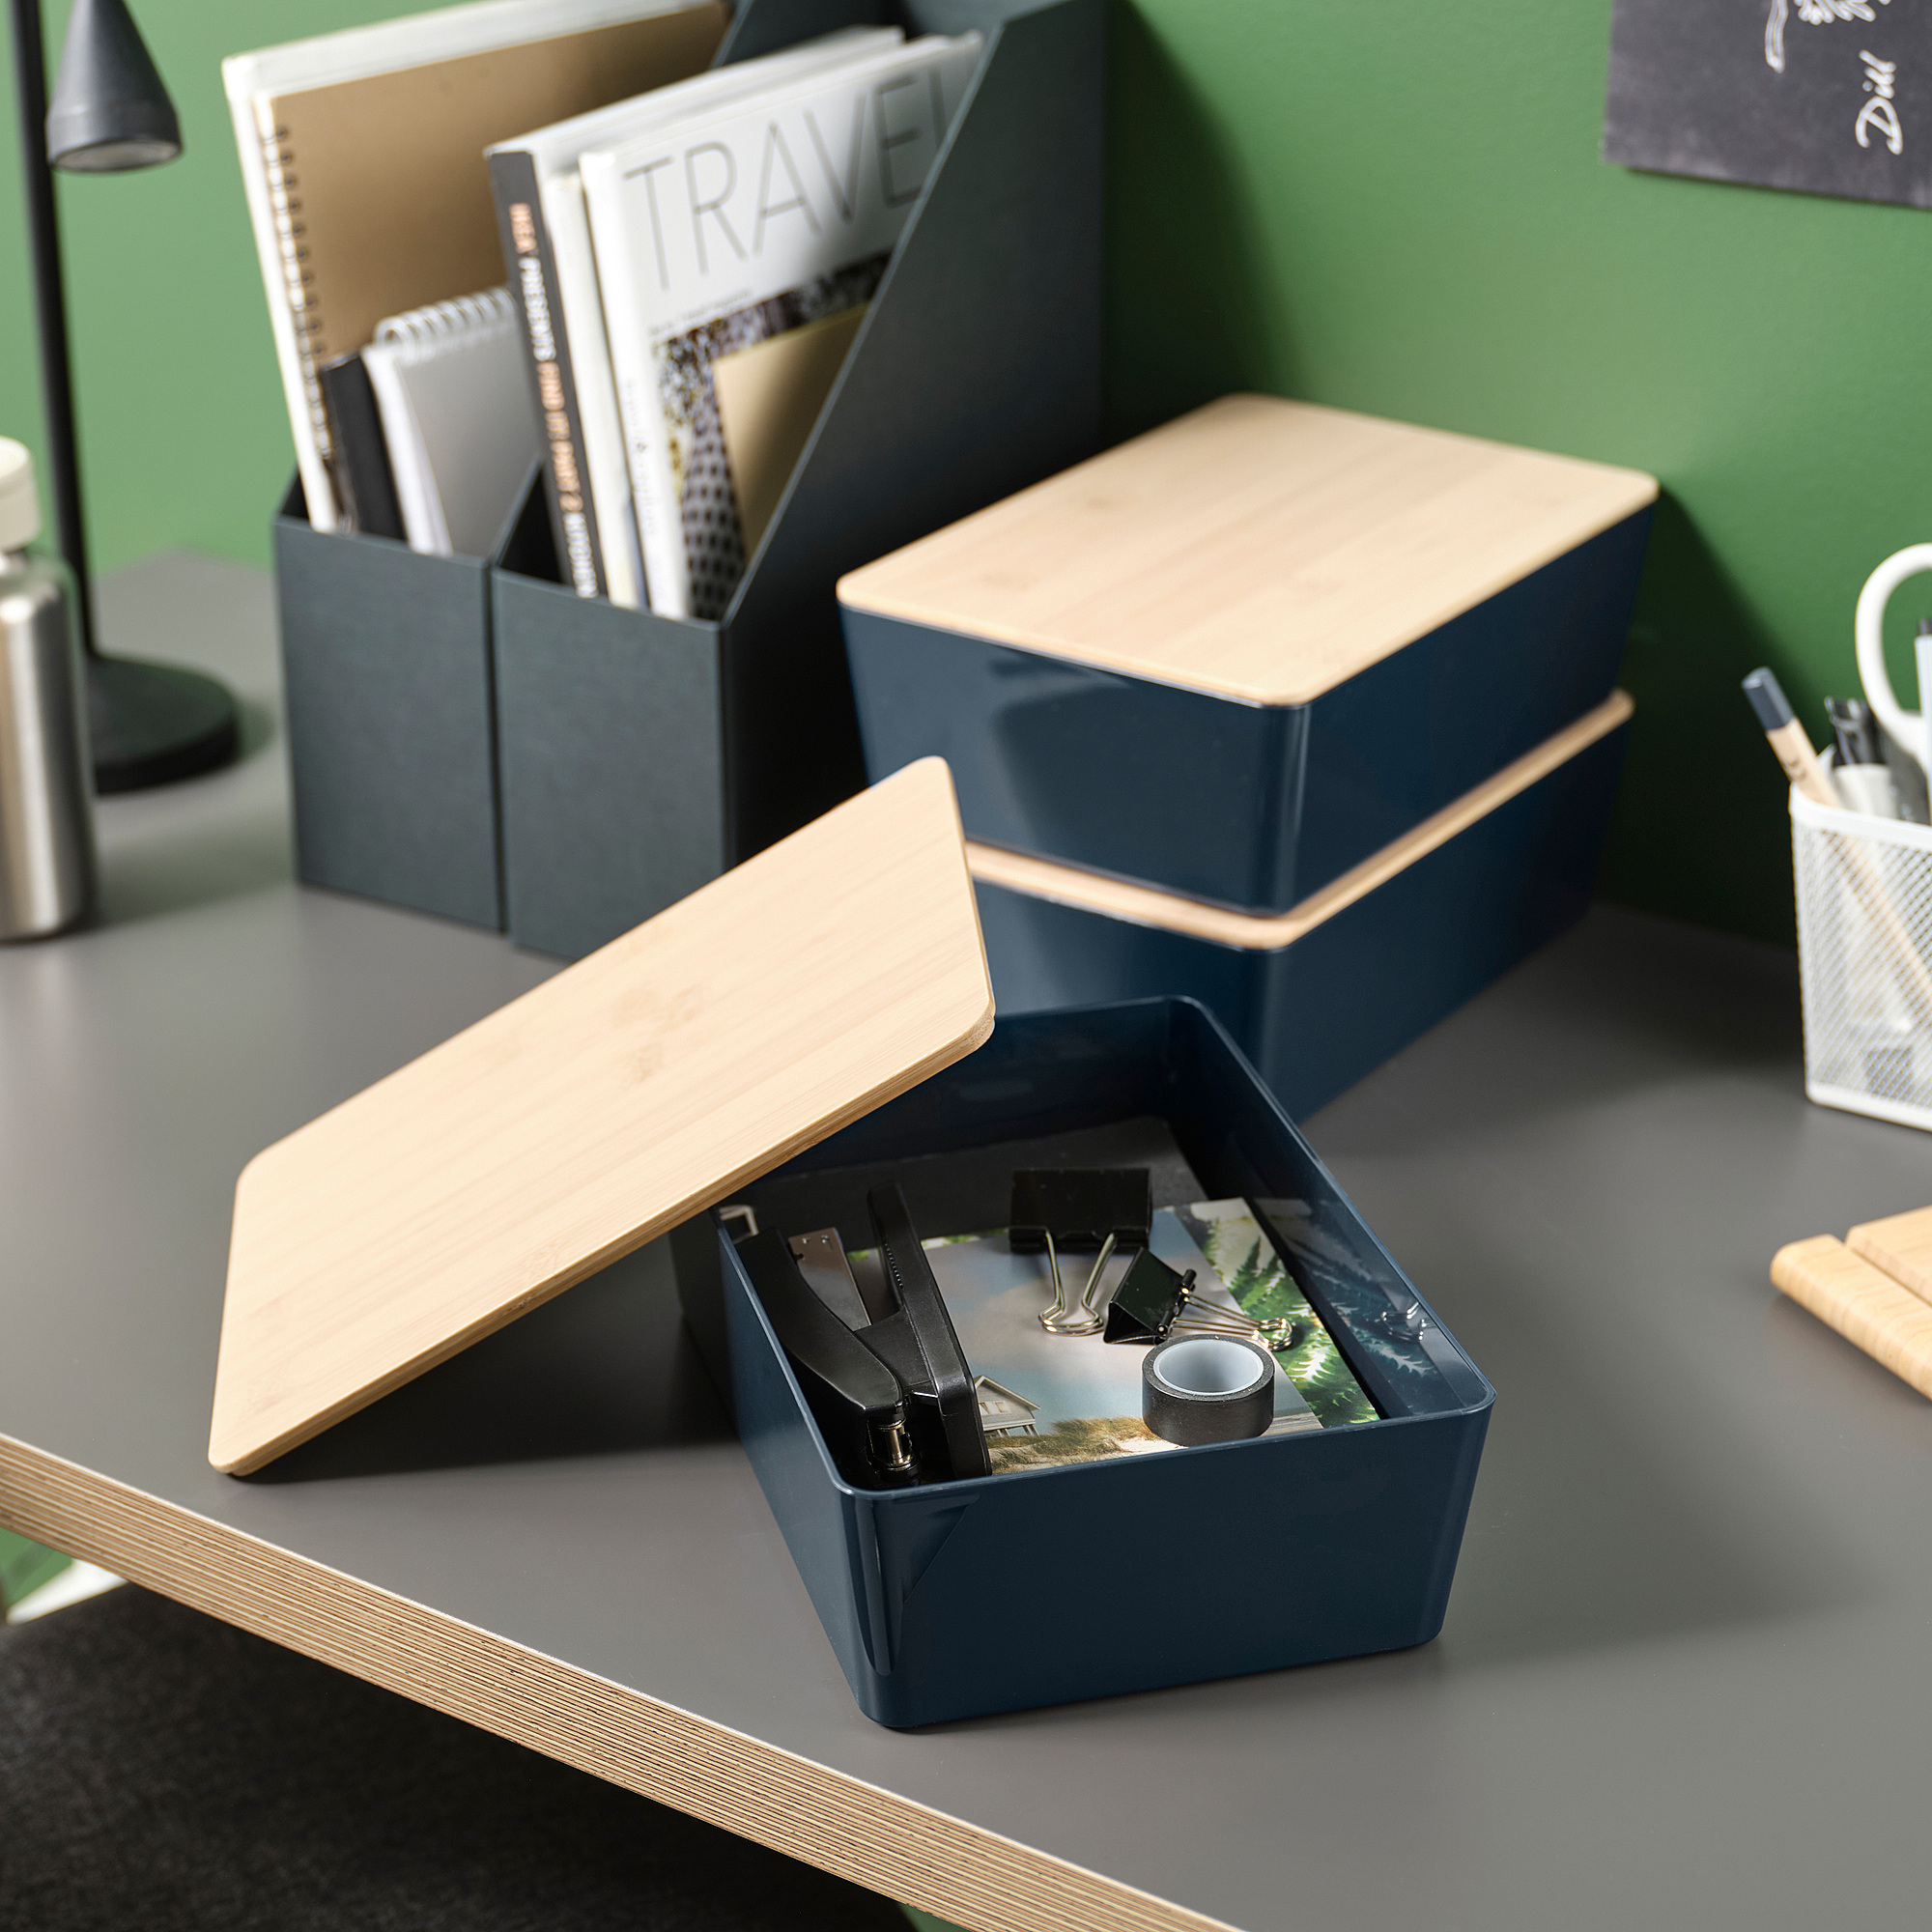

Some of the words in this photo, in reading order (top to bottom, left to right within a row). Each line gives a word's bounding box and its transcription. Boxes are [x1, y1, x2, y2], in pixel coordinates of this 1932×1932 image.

[1855, 49, 1903, 155] Dill
[509, 203, 537, 254] IKEA
[518, 257, 556, 361] PRESENTS
[536, 361, 565, 411] FIND
[550, 440, 580, 492] PART
[558, 492, 583, 513] 2
